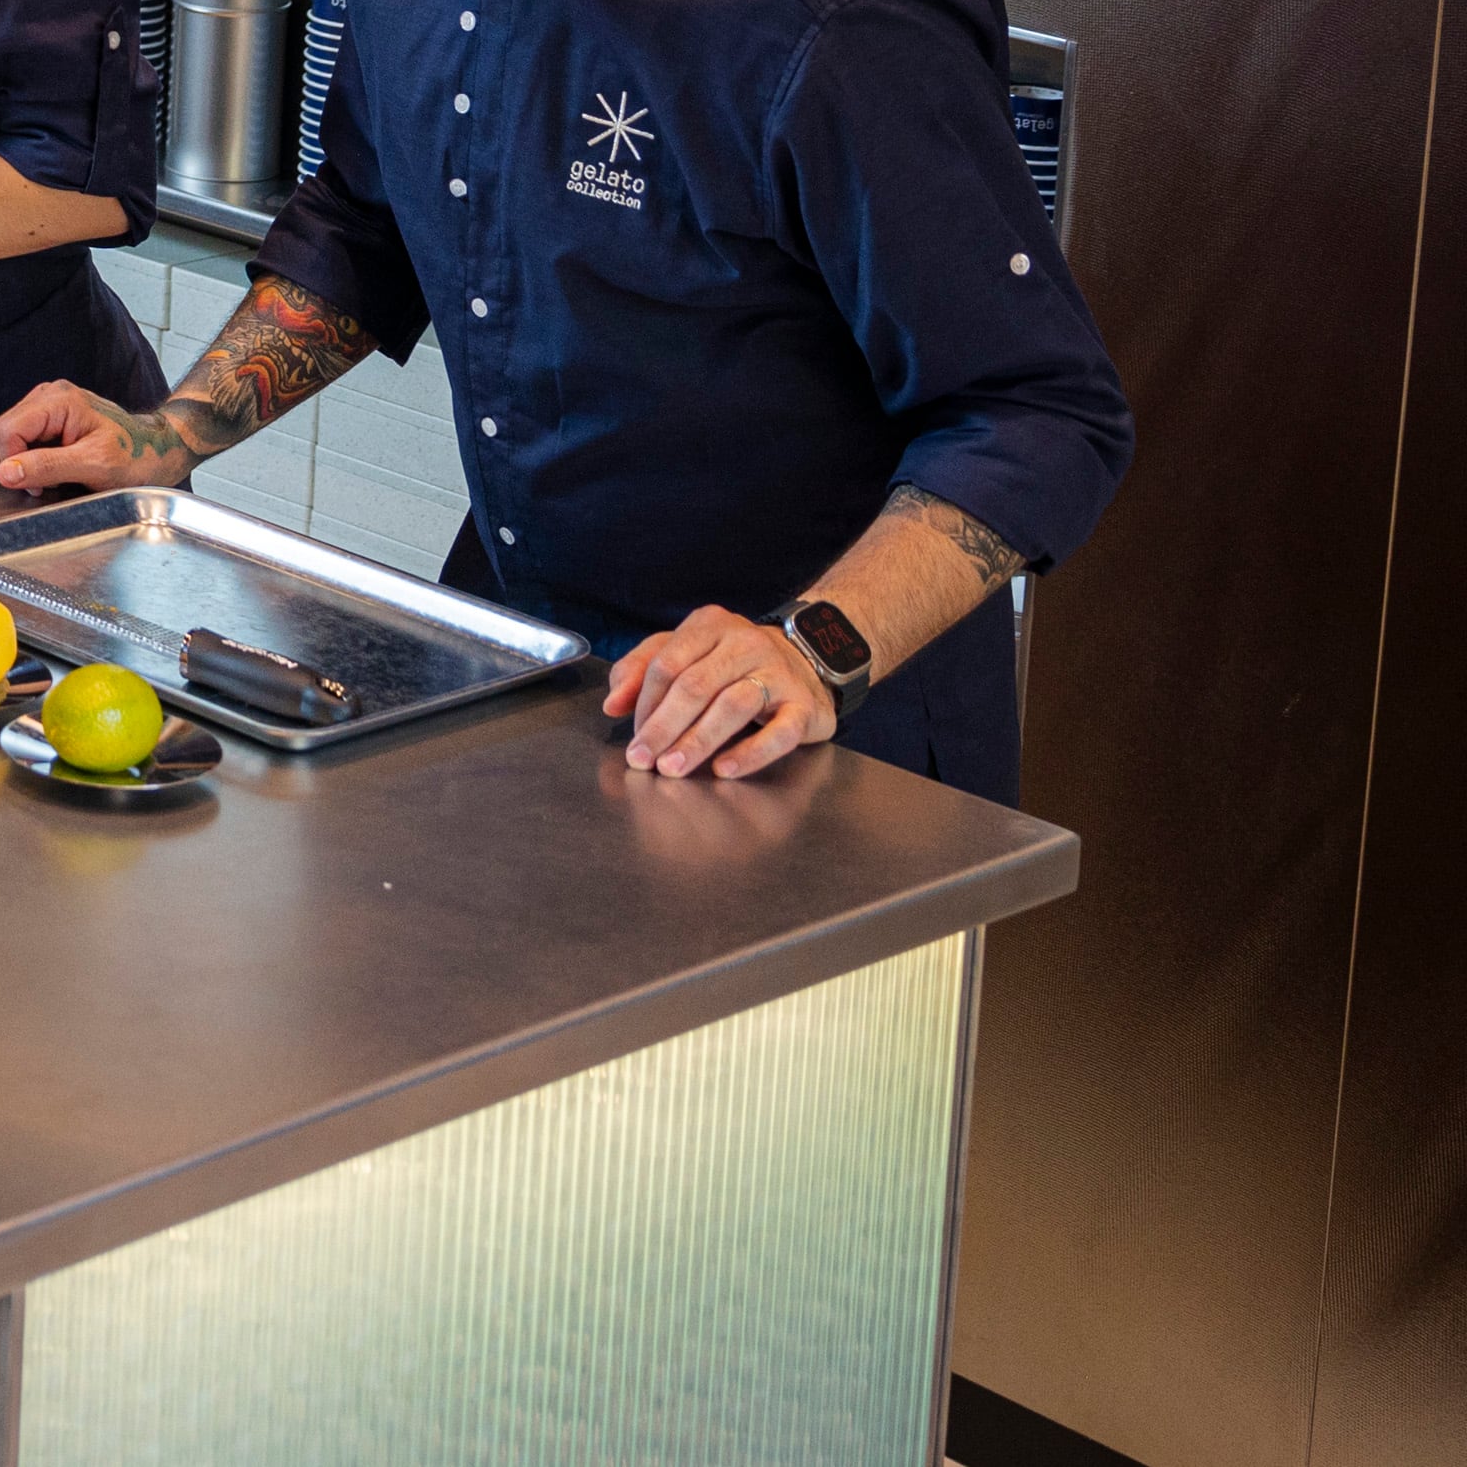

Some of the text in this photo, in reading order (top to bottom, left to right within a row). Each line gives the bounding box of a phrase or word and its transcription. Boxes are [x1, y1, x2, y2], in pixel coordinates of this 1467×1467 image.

[1014, 117, 1055, 133] gelat
[569, 160, 645, 194] gelato
[566, 179, 642, 211] collection
